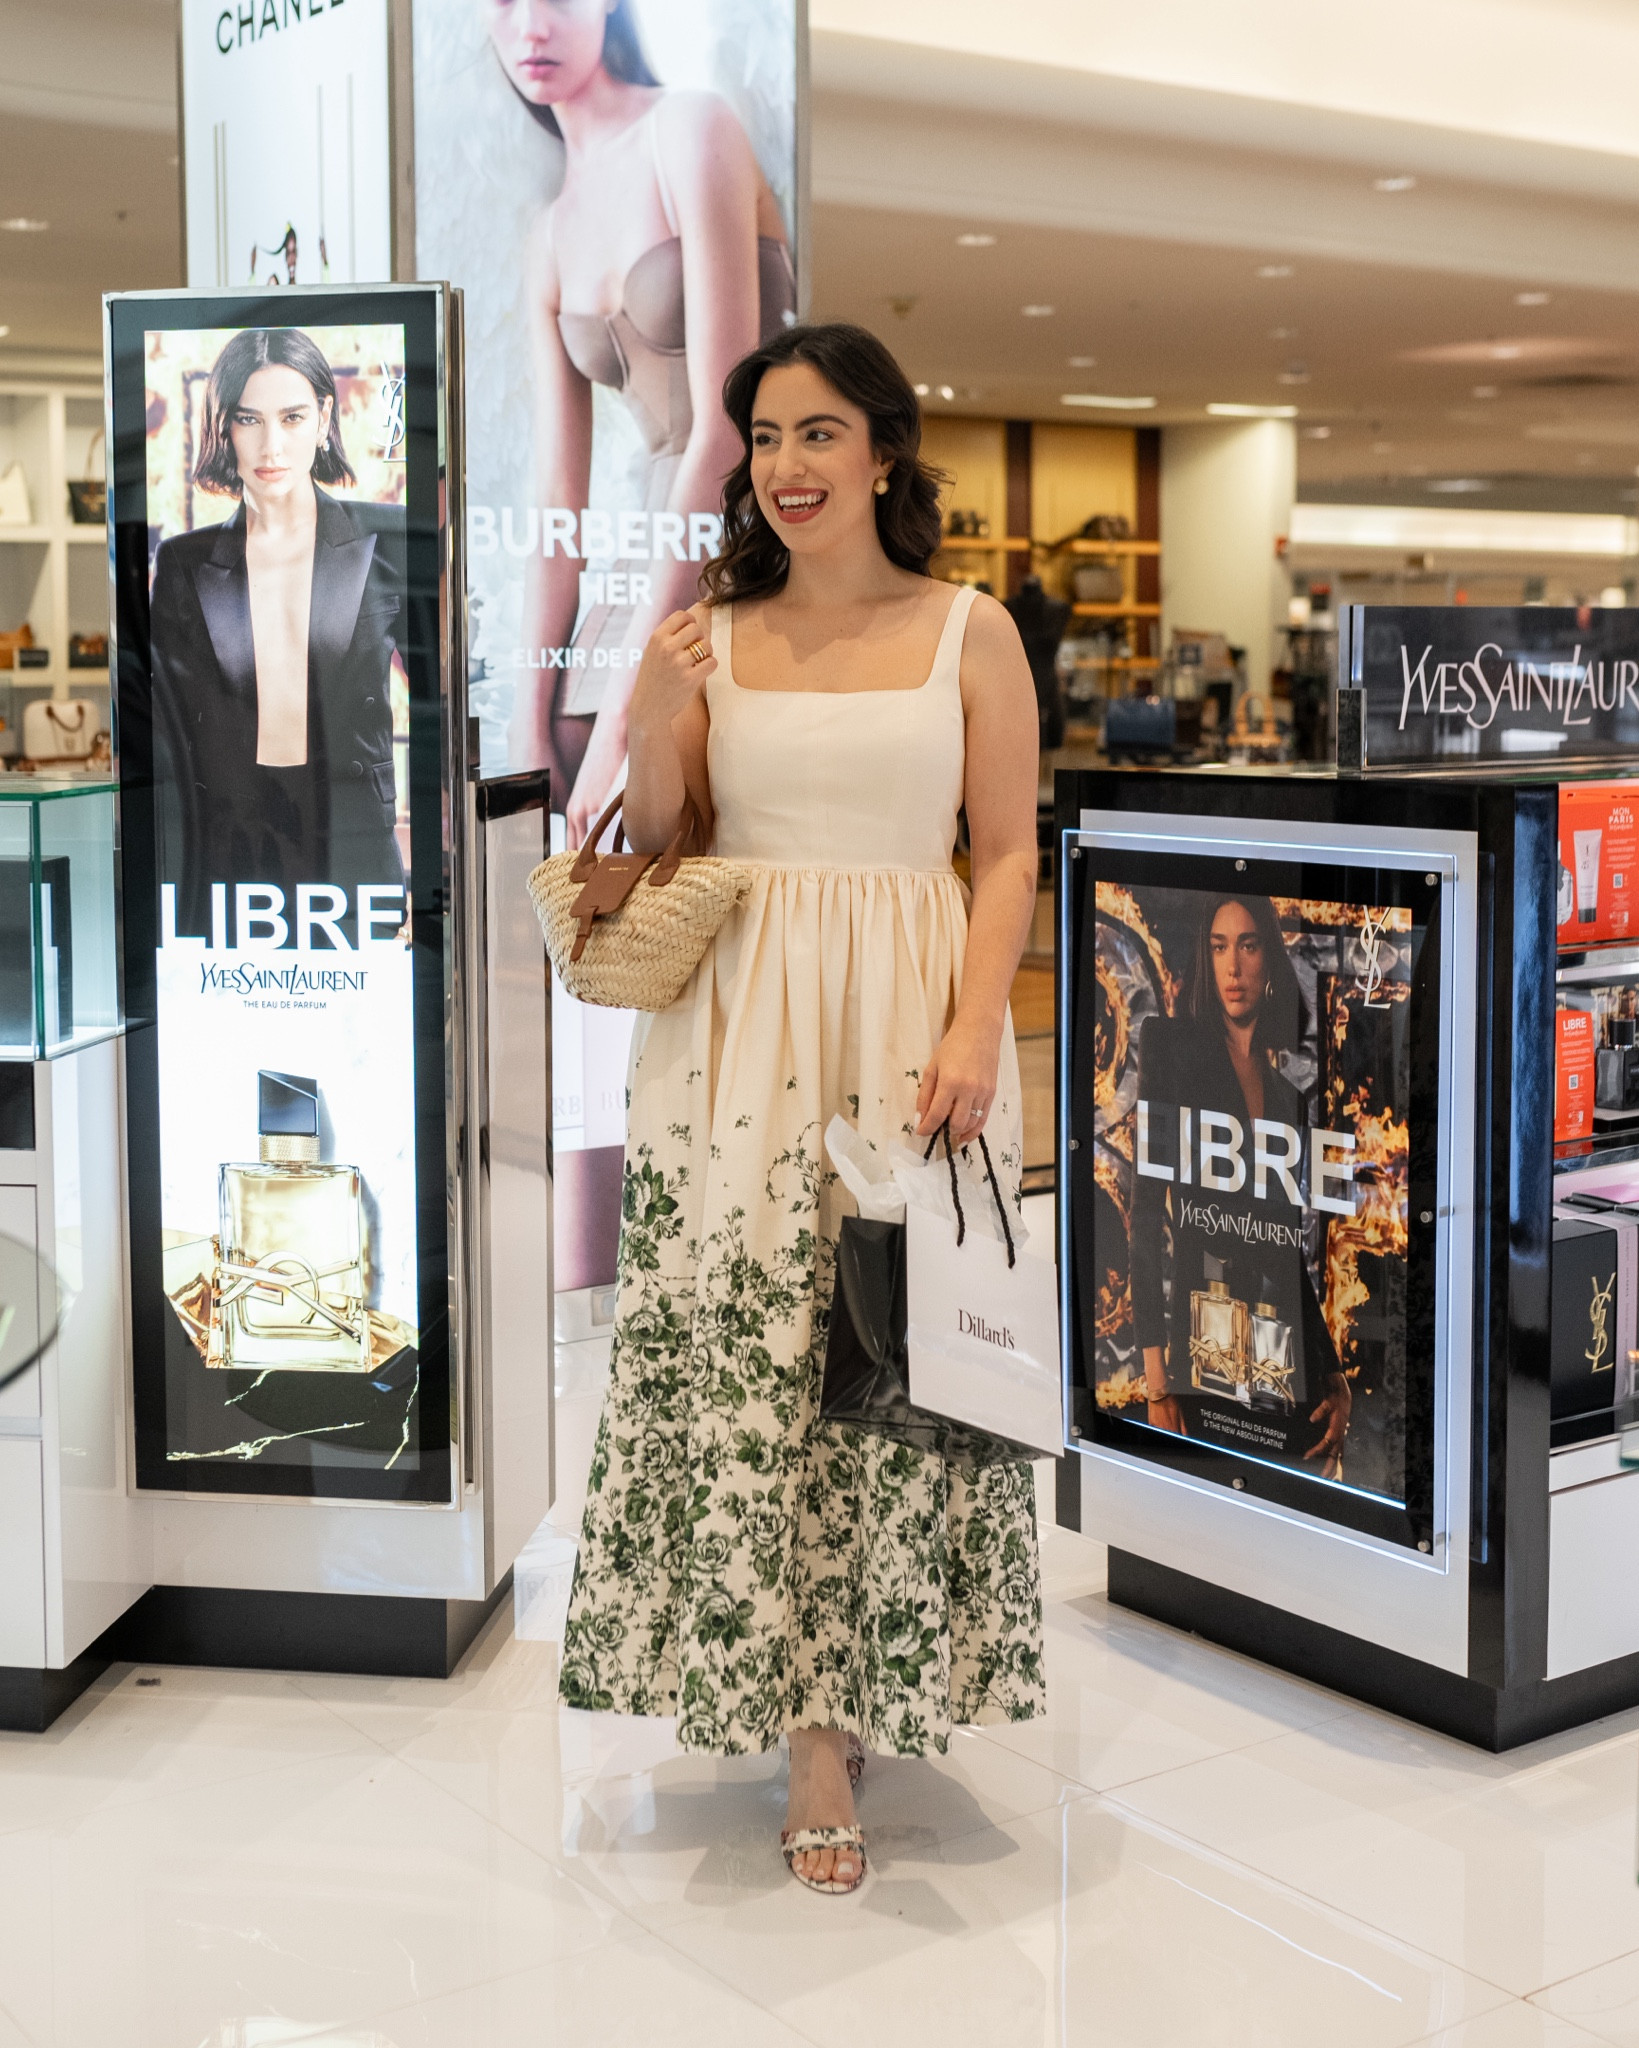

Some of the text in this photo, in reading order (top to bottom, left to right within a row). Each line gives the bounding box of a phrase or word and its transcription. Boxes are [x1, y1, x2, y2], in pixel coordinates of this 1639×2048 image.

[467, 505, 726, 562] BURBERR
[579, 571, 653, 606] HER
[513, 647, 587, 669] ELIXIR
[593, 648, 622, 669] DE
[1608, 814, 1634, 825] PARIS
[1612, 806, 1631, 816] MON
[160, 883, 407, 950] LIBRE
[243, 1000, 327, 1010] THE EAU DE PARFUM
[1562, 1017, 1588, 1031] LIBRE
[1136, 1099, 1357, 1217] LIBRE
[958, 1308, 1015, 1351] Dillard's
[1200, 1408, 1287, 1440] THE ORIGINAL EAU DE PARFUM
[1209, 1421, 1221, 1431] THE
[1221, 1425, 1235, 1435] NEW
[1236, 1428, 1259, 1442] ABSOLU
[1260, 1436, 1284, 1450] PLATINE
